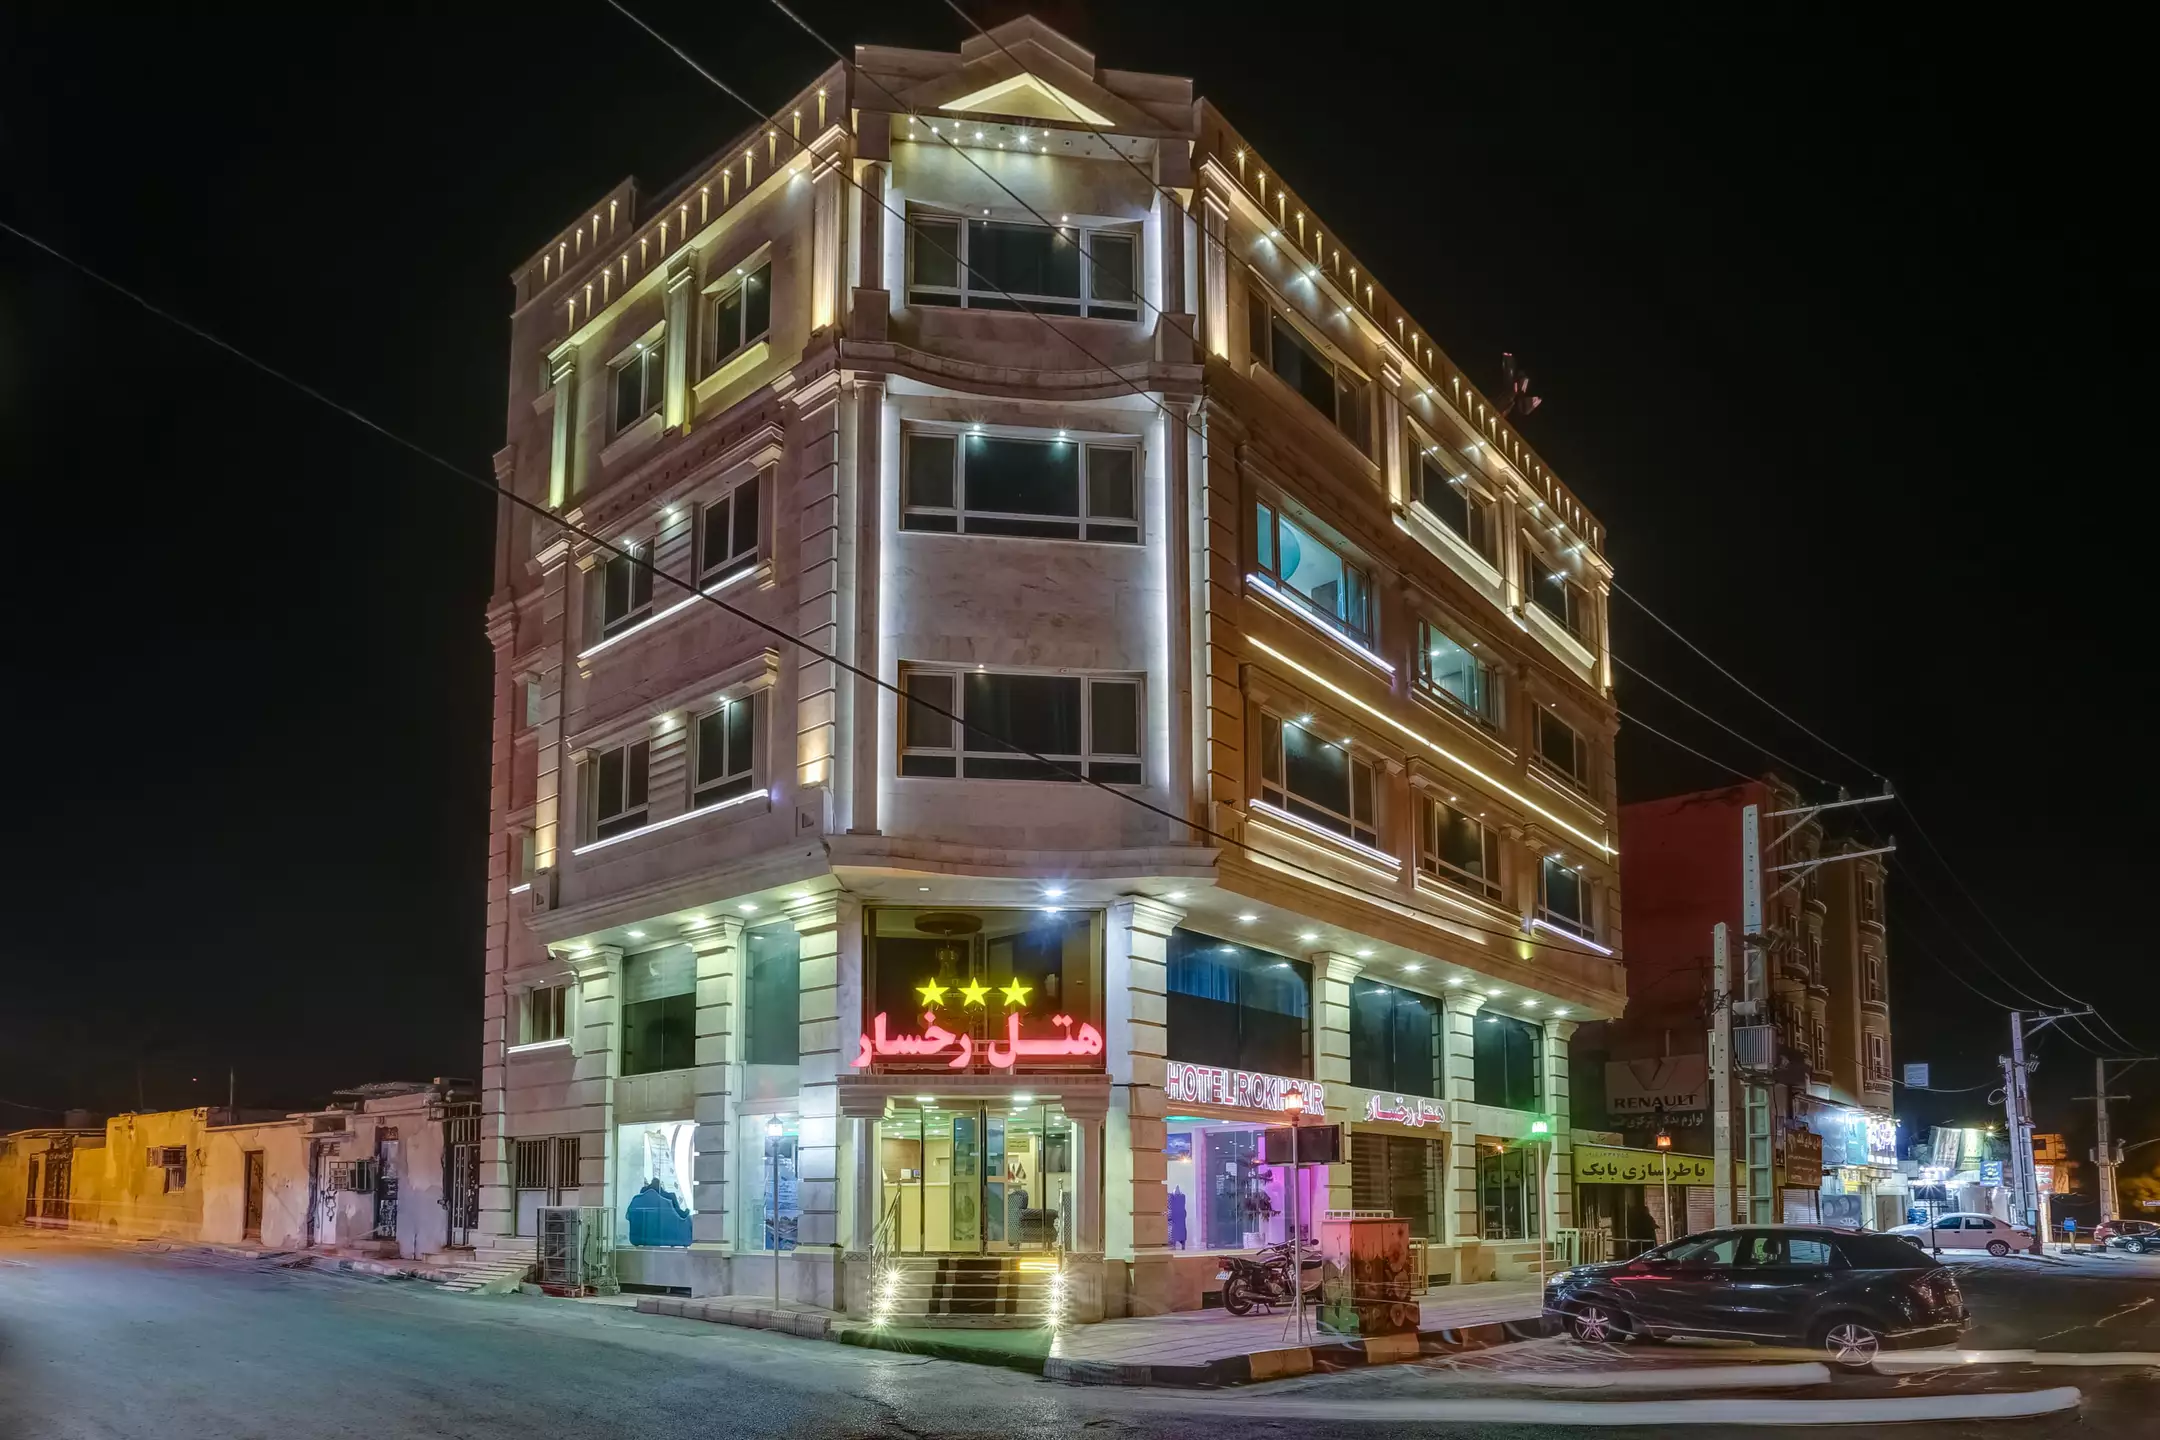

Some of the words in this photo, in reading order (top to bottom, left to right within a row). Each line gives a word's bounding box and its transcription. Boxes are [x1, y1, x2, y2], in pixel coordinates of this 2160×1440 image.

[850, 1011, 972, 1068] رخسار
[988, 1012, 1103, 1068] هتل
[1166, 1062, 1235, 1105] HOTEL
[1364, 1095, 1413, 1126] رخسار
[1414, 1098, 1445, 1127] هتل
[1613, 1093, 1698, 1109] RENAULT
[1681, 1112, 1703, 1127] لوازم
[1582, 1162, 1618, 1180] بابک
